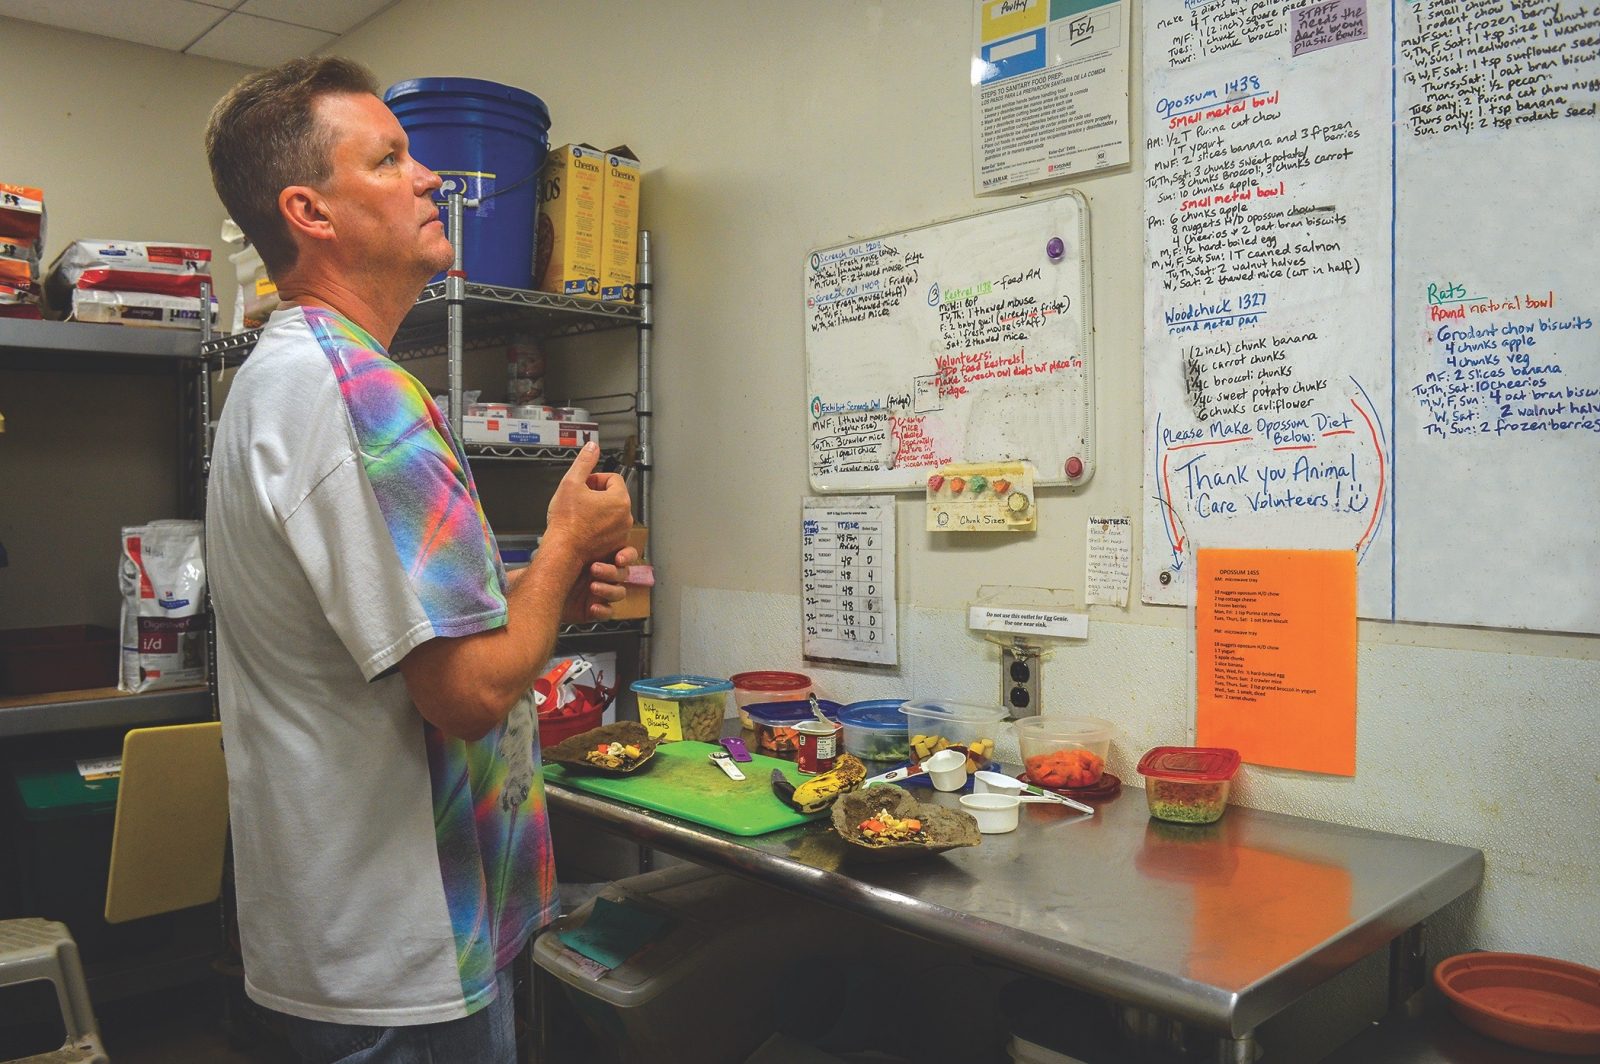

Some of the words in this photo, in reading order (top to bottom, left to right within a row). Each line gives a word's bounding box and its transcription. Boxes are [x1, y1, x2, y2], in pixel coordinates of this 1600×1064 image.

[1212, 7, 1248, 23] rabbit
[1298, 0, 1340, 21] STAFF
[1299, 12, 1336, 29] needs
[1341, 7, 1364, 20] the
[1466, 16, 1515, 32] frozen
[1521, 4, 1559, 20] berry
[1070, 16, 1095, 40] Fish
[1294, 34, 1333, 54] plastic
[1156, 88, 1217, 114] Opossum
[1224, 75, 1261, 93] 1438
[1206, 101, 1246, 119] metal
[1253, 91, 1279, 108] bowl
[1516, 97, 1567, 111] banana
[1565, 103, 1596, 117] seed
[1253, 111, 1281, 123] chow
[1323, 130, 1360, 143] berries
[1198, 149, 1227, 163] slices
[1230, 138, 1272, 154] banana
[1277, 131, 1297, 144] and
[574, 159, 599, 172] Cheerios
[1315, 148, 1353, 165] carrot
[611, 168, 635, 181] Cheerios
[1192, 182, 1224, 195] chunks
[1227, 178, 1259, 194] apple
[1214, 190, 1251, 205] metal
[1256, 182, 1285, 198] bowl
[1182, 207, 1217, 222] chunks
[1219, 203, 1248, 221] apple
[1182, 217, 1221, 234] nuggets
[1184, 228, 1227, 245] Cheerios
[1306, 214, 1347, 226] biscuits
[1248, 242, 1291, 259] canned
[1294, 242, 1341, 253] salmon
[1261, 235, 1277, 248] egg
[1427, 282, 1466, 304] Rats
[1165, 300, 1231, 324] Woodchuck
[1238, 293, 1266, 310] 1327
[1432, 305, 1466, 321] Round
[1525, 291, 1553, 308] bowl
[1204, 317, 1234, 331] metal
[1238, 316, 1258, 326] pan
[1502, 322, 1534, 334] chow
[1539, 317, 1592, 330] biscuits
[1235, 339, 1266, 354] chunk
[1272, 332, 1318, 348] banana
[1458, 339, 1497, 353] chunks
[1502, 336, 1536, 352] apple
[935, 351, 992, 369] Volunteers:
[1213, 356, 1246, 371] carrot
[1250, 351, 1285, 365] chunks
[1507, 354, 1530, 368] veg
[1214, 370, 1253, 386] broccoli
[1258, 365, 1292, 379] chunks
[1468, 366, 1505, 379] slices
[1512, 365, 1562, 376] banana
[1217, 389, 1248, 402] sweet
[1252, 386, 1288, 404] potato
[1293, 380, 1327, 393] chunks
[1209, 404, 1246, 418] chunks
[1253, 398, 1314, 416] cauliflower
[1210, 422, 1252, 438] Make
[1257, 419, 1309, 439] Opossum
[1311, 413, 1352, 431] Diet
[1495, 419, 1547, 436] frozen
[1273, 431, 1315, 444] Below:
[1175, 454, 1249, 499] Thank
[1257, 466, 1286, 495] you
[1293, 453, 1357, 482] Animal
[1198, 493, 1237, 518] Care
[960, 512, 980, 525] Chunk
[984, 513, 1005, 524] Sizes
[144, 639, 162, 651] i/d
